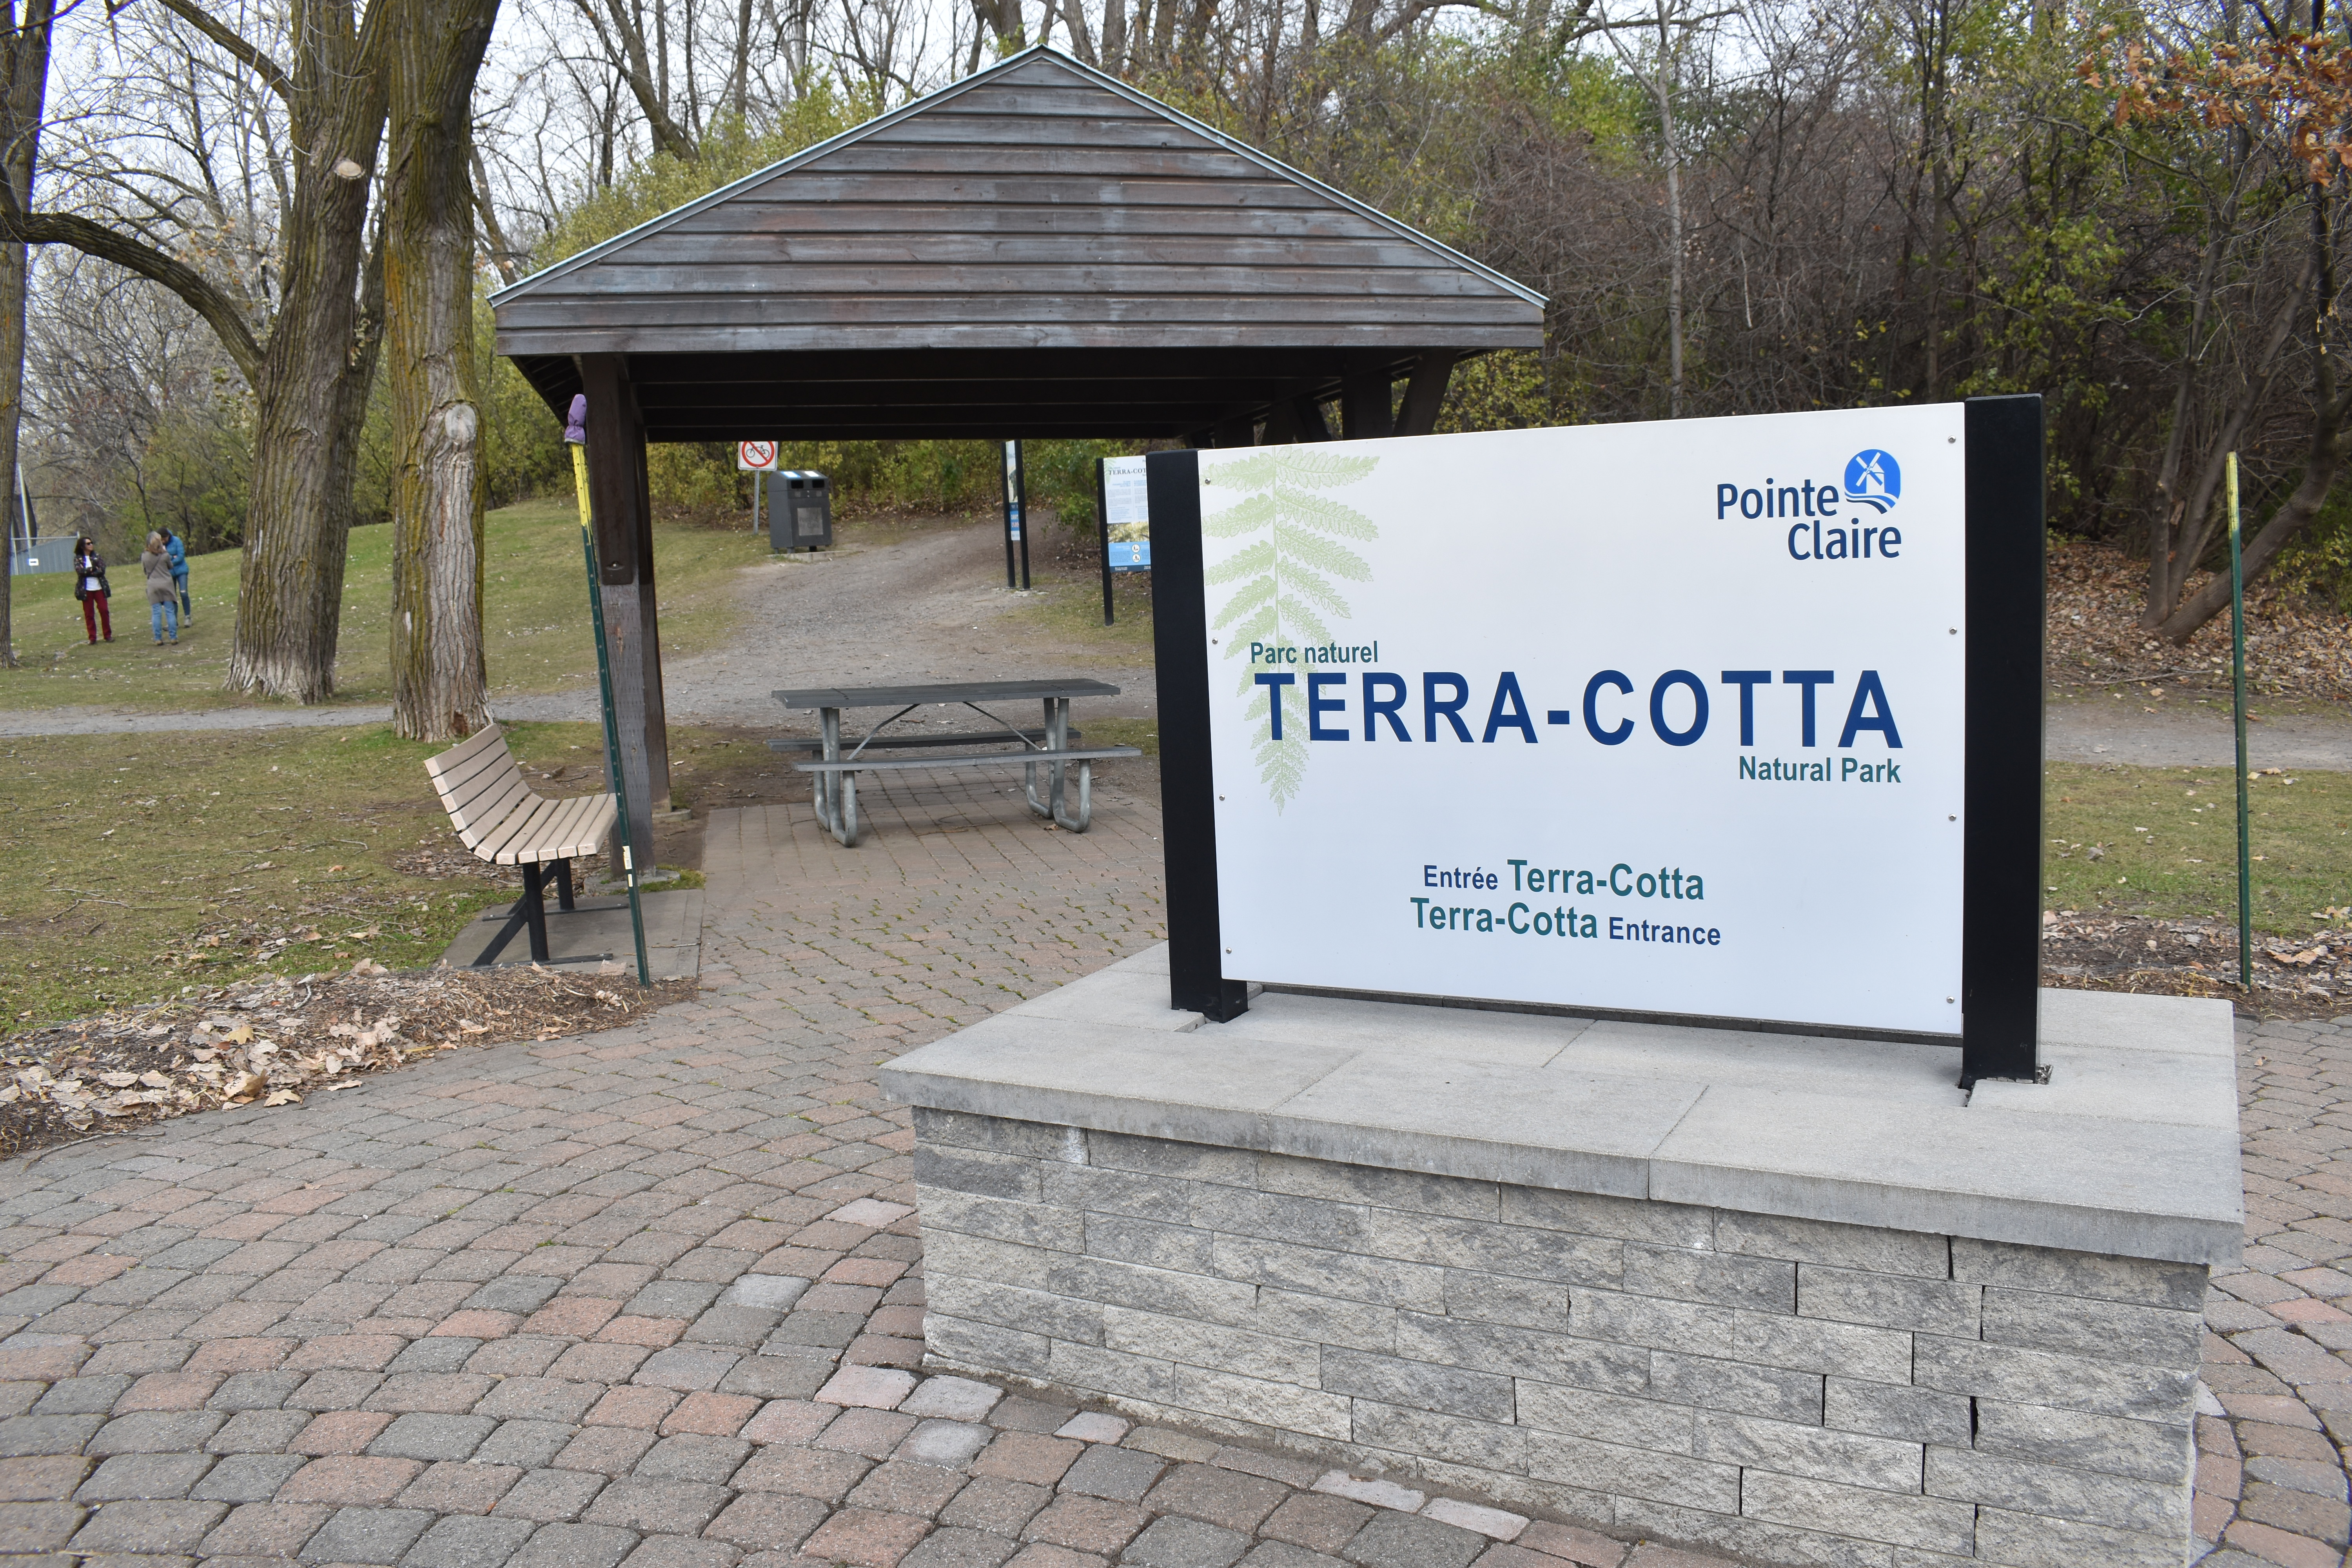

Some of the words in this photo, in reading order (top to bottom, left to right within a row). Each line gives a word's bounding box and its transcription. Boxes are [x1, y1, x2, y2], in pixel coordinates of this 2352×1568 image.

[1717, 477, 1839, 520] Pointe
[1788, 517, 1902, 561] Claire
[1250, 642, 1298, 664] Parc
[1304, 640, 1378, 664] naturel
[1253, 669, 1904, 749] TERRA-COTTA
[1739, 755, 1831, 782] Natural
[1842, 757, 1902, 783] Park
[1424, 864, 1499, 890] Entrée
[1507, 859, 1704, 900] Terra-Cotta
[1410, 897, 1598, 939] Terra-Cotta
[1609, 916, 1721, 946] Entrance
